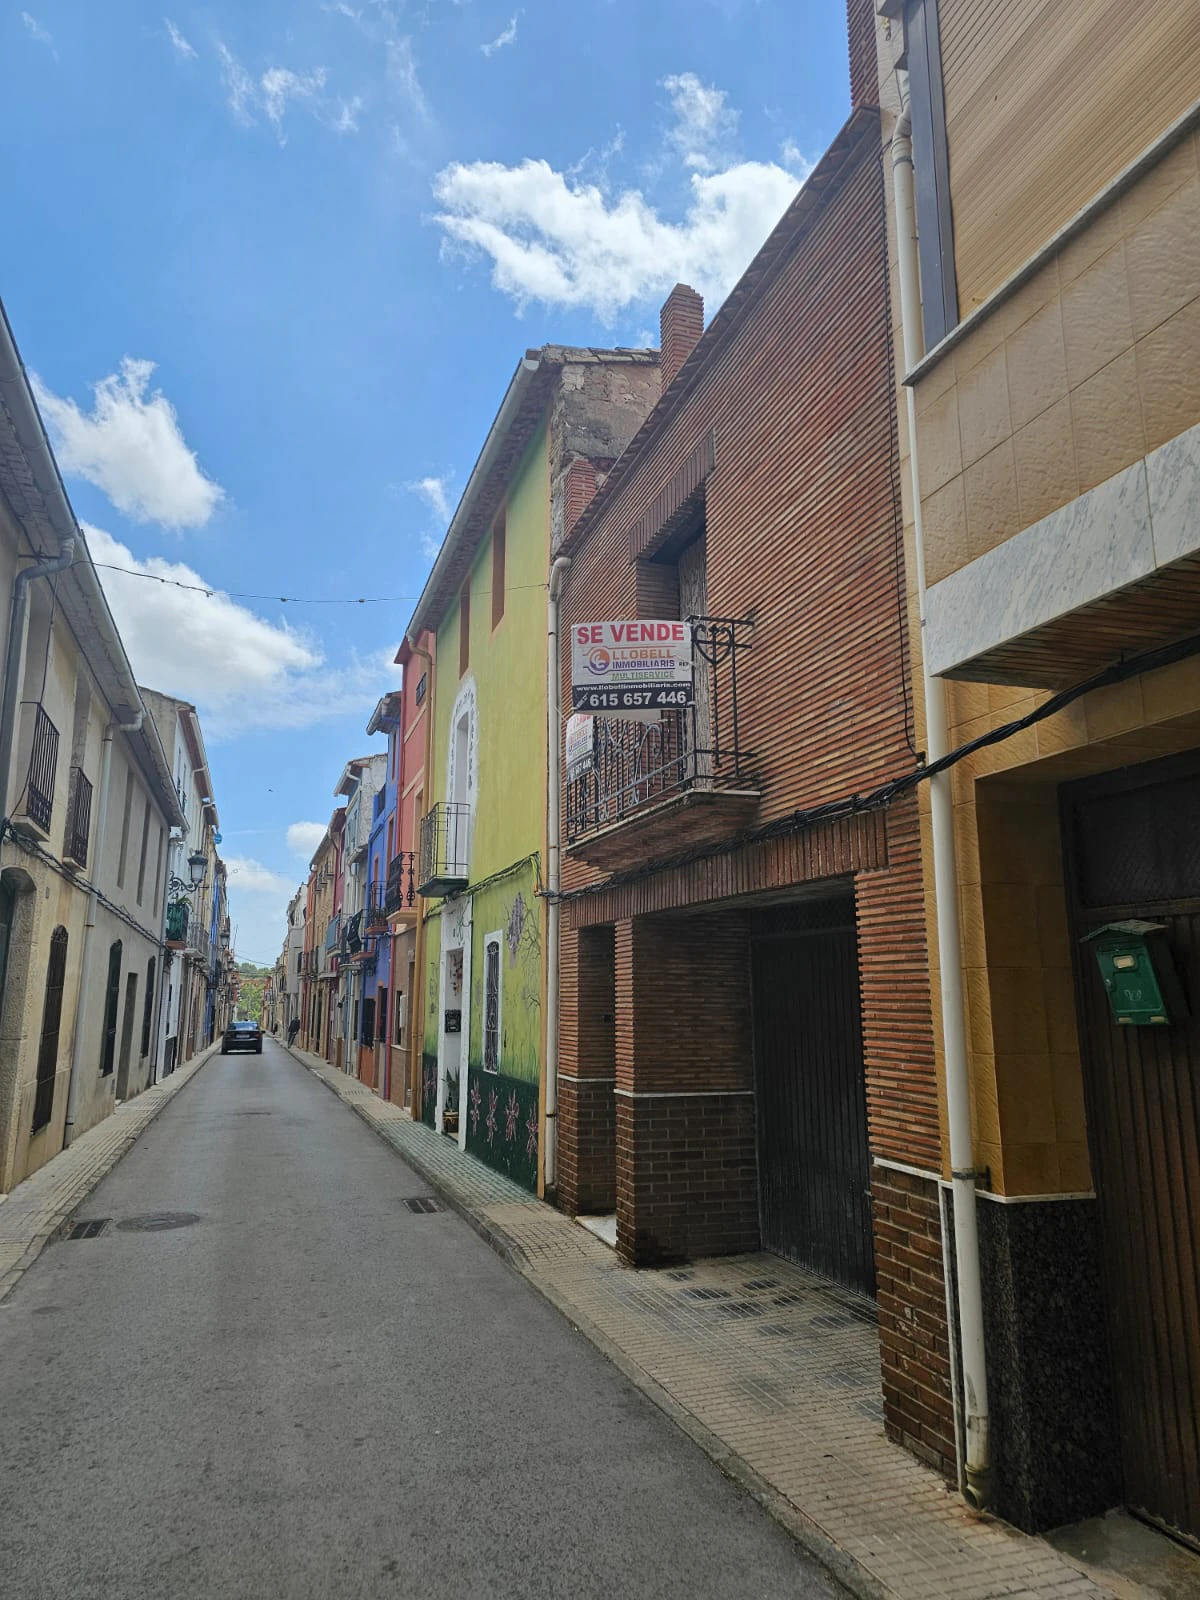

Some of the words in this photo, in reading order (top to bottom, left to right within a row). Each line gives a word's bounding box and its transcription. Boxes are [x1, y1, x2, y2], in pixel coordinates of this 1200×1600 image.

[577, 625, 603, 644] SE
[610, 623, 684, 642] VENDE
[612, 649, 675, 660] LLOBELL
[612, 659, 675, 669] INMOBILIARIS
[611, 671, 675, 681] MULTISERVICE
[589, 693, 618, 706] 615
[623, 692, 652, 705] 657
[656, 691, 686, 704] 446
